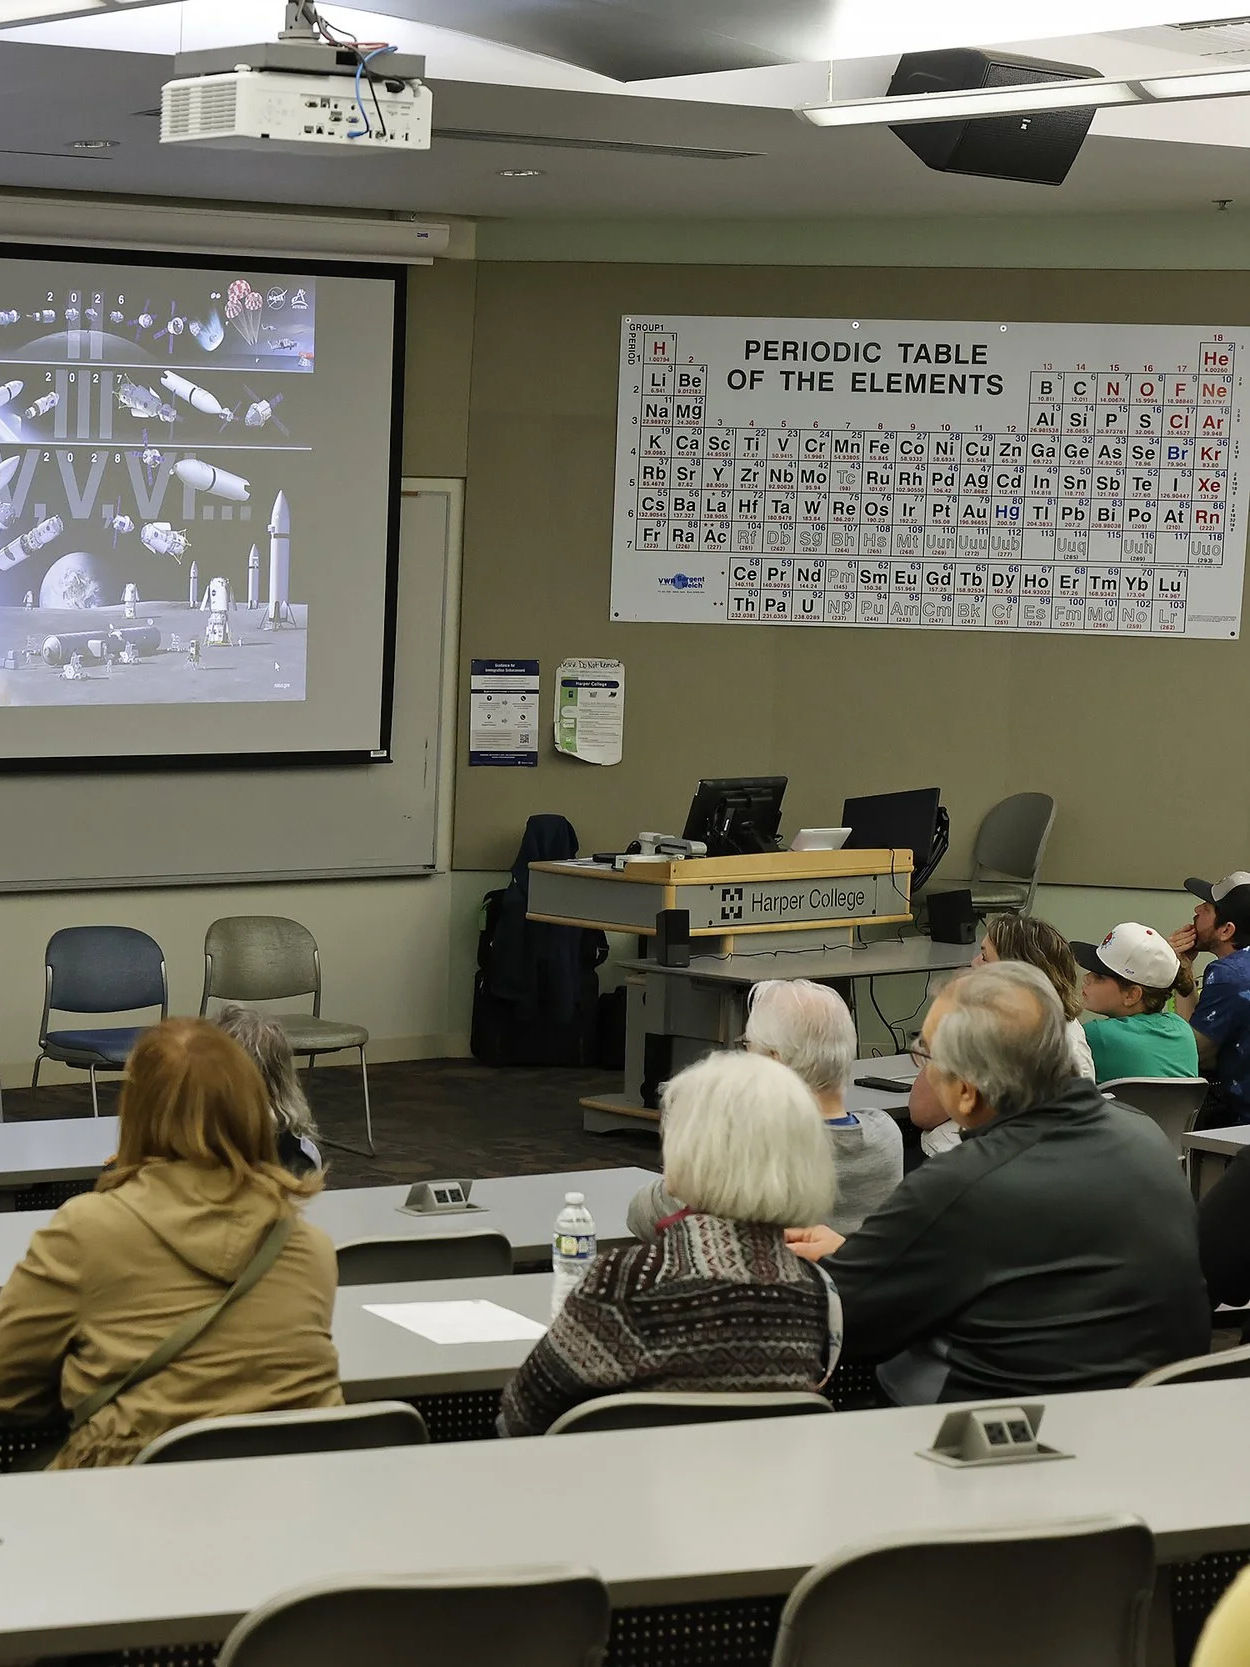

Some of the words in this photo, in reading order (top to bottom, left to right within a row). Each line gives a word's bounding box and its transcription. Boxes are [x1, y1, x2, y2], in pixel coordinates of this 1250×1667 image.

[627, 332, 636, 365] PERIOD
[654, 341, 666, 355] H
[744, 340, 881, 363] PERIODIC
[898, 343, 988, 364] TABLE
[1204, 351, 1229, 366] He
[1143, 364, 1153, 372] 16
[651, 373, 666, 387] Li
[679, 373, 702, 388] Be
[727, 369, 764, 390] OF
[780, 371, 834, 391] THE
[851, 372, 1003, 395] ELEMENTS
[1040, 380, 1052, 395] B
[1074, 381, 1086, 396] C
[1107, 382, 1120, 396] N
[1140, 382, 1154, 396] O
[1176, 383, 1186, 397] F
[1202, 383, 1227, 398] Ne
[646, 404, 668, 418] Na
[676, 404, 702, 420] Mg
[1036, 412, 1054, 426] Al
[1070, 412, 1087, 427] Si
[1106, 413, 1117, 428] P
[1139, 414, 1151, 428] S
[1170, 414, 1189, 429] Cl
[1202, 415, 1224, 429] Ar
[974, 424, 982, 432] 11
[650, 435, 662, 449] K
[676, 435, 699, 450] Ca
[708, 436, 730, 451] Sc
[744, 437, 759, 451] Ti
[777, 438, 789, 452] V
[805, 438, 826, 453] Cr
[834, 439, 860, 454] Mn
[869, 440, 890, 454] Fe
[900, 440, 924, 455] Co
[936, 441, 954, 456] Ni
[965, 442, 990, 457] Cu
[999, 442, 1022, 457] Zn
[1031, 443, 1056, 458] Ga
[1064, 444, 1089, 459] Ge
[1098, 444, 1122, 459] As
[1132, 445, 1156, 460] Se
[1168, 446, 1188, 460] Br
[1201, 446, 1222, 461] Kr
[643, 466, 666, 480] Rb
[677, 466, 696, 481] Sr
[712, 467, 724, 481] Y
[740, 468, 760, 482] Zr
[770, 468, 794, 483] Nb
[800, 469, 827, 484] Mo
[866, 471, 890, 485] Ru
[899, 472, 922, 486] Rh
[932, 472, 955, 487] Pd
[964, 473, 988, 489] Ag
[996, 474, 1022, 488] Cd
[1034, 474, 1050, 489] In
[1063, 475, 1086, 490] Sn
[1096, 476, 1120, 491] Sb
[1132, 476, 1152, 491] Te
[1198, 478, 1221, 492] Xe
[642, 496, 665, 512] Cs
[671, 497, 696, 512] Ba
[706, 498, 726, 513] La
[738, 499, 758, 514] Hf
[771, 500, 790, 514] Ta
[804, 500, 821, 514] W
[833, 501, 856, 516] Re
[864, 502, 889, 516] Os
[903, 503, 916, 517] Ir
[932, 504, 951, 518] Pt
[962, 504, 986, 519] Au
[995, 504, 1020, 520] Hg
[1032, 506, 1048, 520] Tl
[1061, 506, 1085, 521] Pb
[1098, 508, 1116, 522] Bi
[1128, 508, 1152, 523] Po
[1164, 509, 1184, 524] At
[1195, 510, 1220, 524] Rn
[643, 528, 661, 542] Fr
[746, 523, 762, 532] 104
[778, 524, 794, 532] 105
[811, 524, 826, 533] 106
[843, 525, 859, 533] 107
[875, 526, 891, 534] 108
[908, 526, 924, 535] 109
[940, 527, 956, 536] 110
[672, 528, 694, 543] Ra
[704, 529, 726, 544] Ac
[734, 566, 757, 581] Ce
[768, 567, 787, 581] Pr
[797, 568, 821, 582] Nd
[860, 569, 888, 584] Sm
[895, 570, 917, 585] Eu
[926, 571, 951, 586] Gd
[960, 572, 982, 587] Tb
[992, 573, 1016, 589] Dy
[1024, 574, 1049, 588] Ho
[1060, 575, 1079, 589] Er
[1089, 576, 1117, 590] Tm
[1125, 576, 1148, 591] Yb
[1159, 578, 1181, 592] Lu
[733, 597, 755, 612] Th
[765, 598, 786, 612] Pa
[802, 599, 814, 613] U
[751, 892, 805, 916] Harper
[809, 888, 865, 911] College
